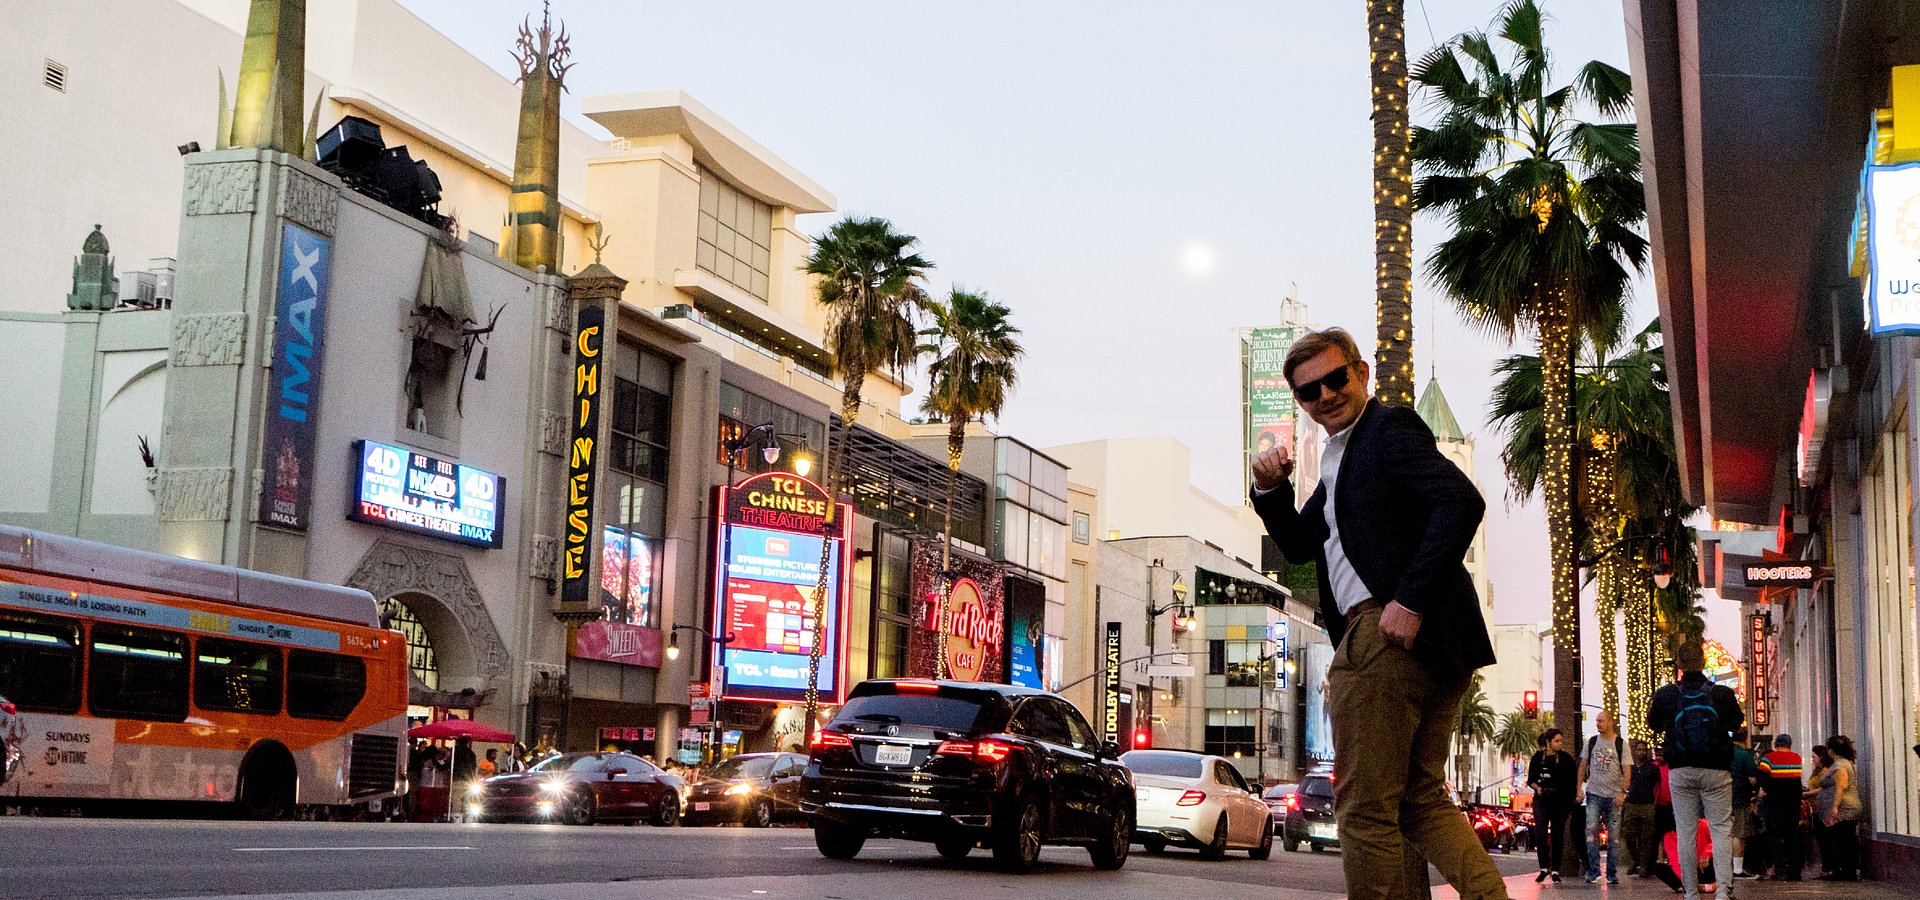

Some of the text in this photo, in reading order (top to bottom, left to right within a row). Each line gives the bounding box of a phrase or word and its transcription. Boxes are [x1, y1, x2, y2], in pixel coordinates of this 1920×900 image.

[279, 241, 320, 423] IMAX
[1253, 339, 1292, 349] HOLLYWOOD
[1254, 362, 1284, 372] PARAD
[367, 447, 401, 477] 4D
[566, 325, 599, 579] CHINESE
[464, 473, 494, 501] 4D
[771, 477, 805, 495] TCL
[748, 491, 826, 516] CHINESE
[271, 512, 298, 526] IMAX
[361, 501, 387, 520] TCL
[386, 507, 425, 527] CHINESE
[424, 515, 462, 535] THEATRE
[461, 524, 493, 543] IMAX
[740, 506, 825, 532] THEATRE
[1747, 566, 1812, 580] HOOTERS
[19, 590, 147, 617] SINGLE MOM IS LOSING FAITH
[970, 604, 1001, 653] Rock
[733, 662, 763, 677] TCL
[956, 653, 975, 669] CAFE
[1754, 618, 1765, 723] SOUVENIRS
[1106, 630, 1119, 732] DOLBY THEATRE
[45, 731, 90, 743] SUNDAYS
